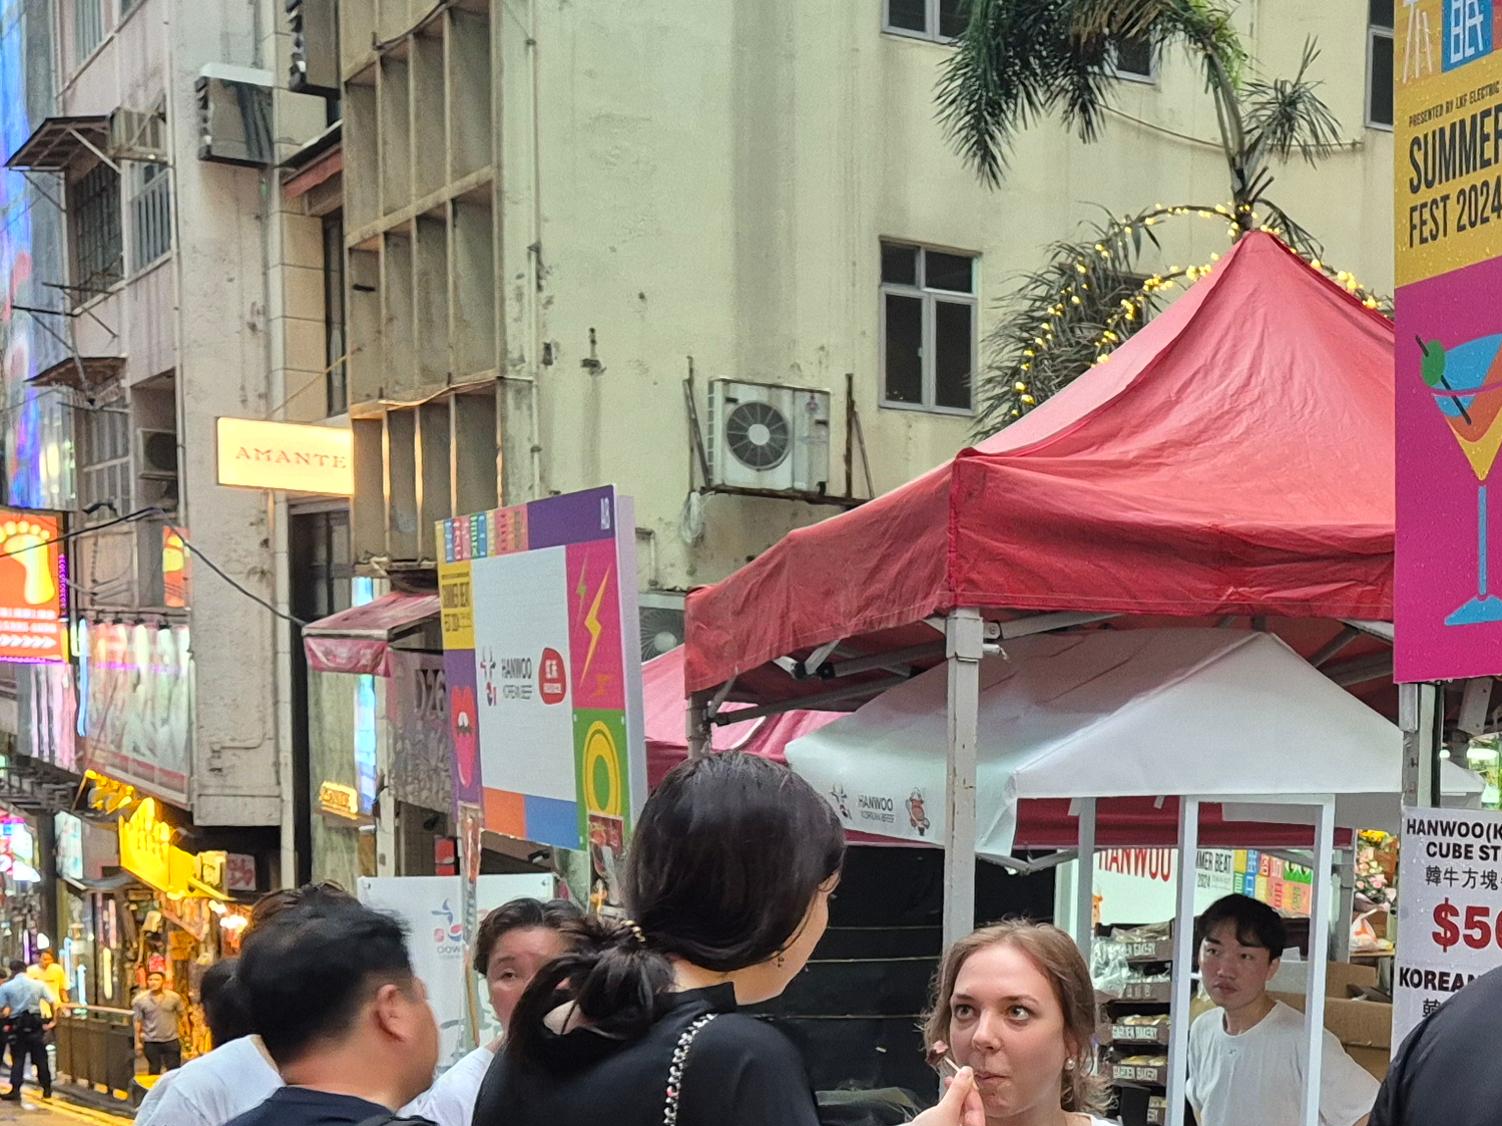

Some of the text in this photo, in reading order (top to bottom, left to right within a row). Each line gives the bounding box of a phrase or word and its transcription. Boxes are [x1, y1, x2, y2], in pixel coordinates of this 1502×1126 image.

[1409, 106, 1444, 128] PRESENTED
[1469, 80, 1500, 104] ELECTRIC
[1409, 175, 1502, 248] FEST 2024
[235, 446, 347, 469] AMANTE
[1426, 842, 1476, 861] CUBE
